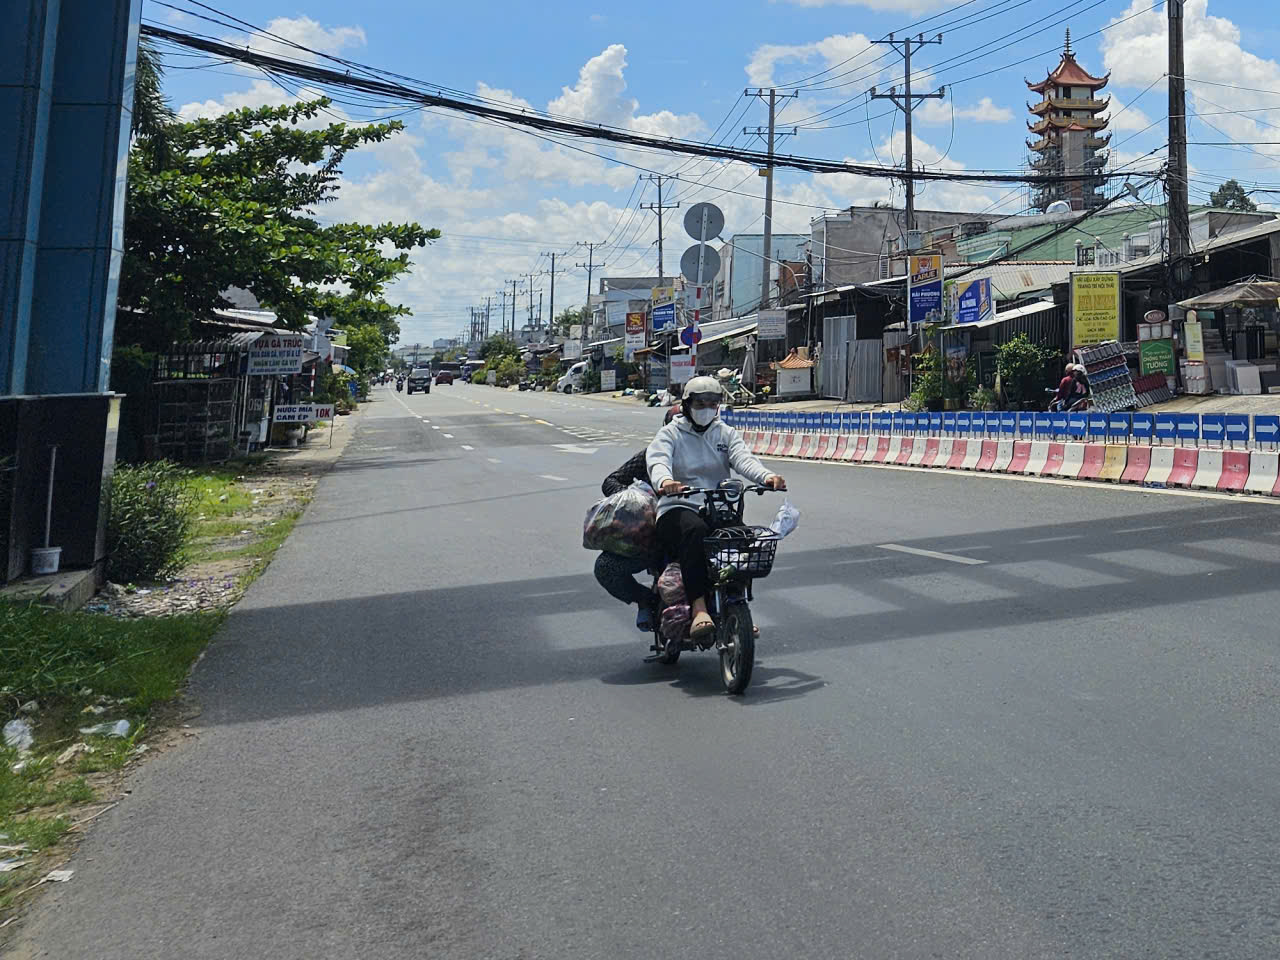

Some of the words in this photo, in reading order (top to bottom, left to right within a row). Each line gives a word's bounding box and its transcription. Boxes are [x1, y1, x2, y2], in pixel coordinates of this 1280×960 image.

[913, 270, 936, 283] LARUE
[271, 338, 281, 348] GÀ
[315, 407, 331, 418] 10K
